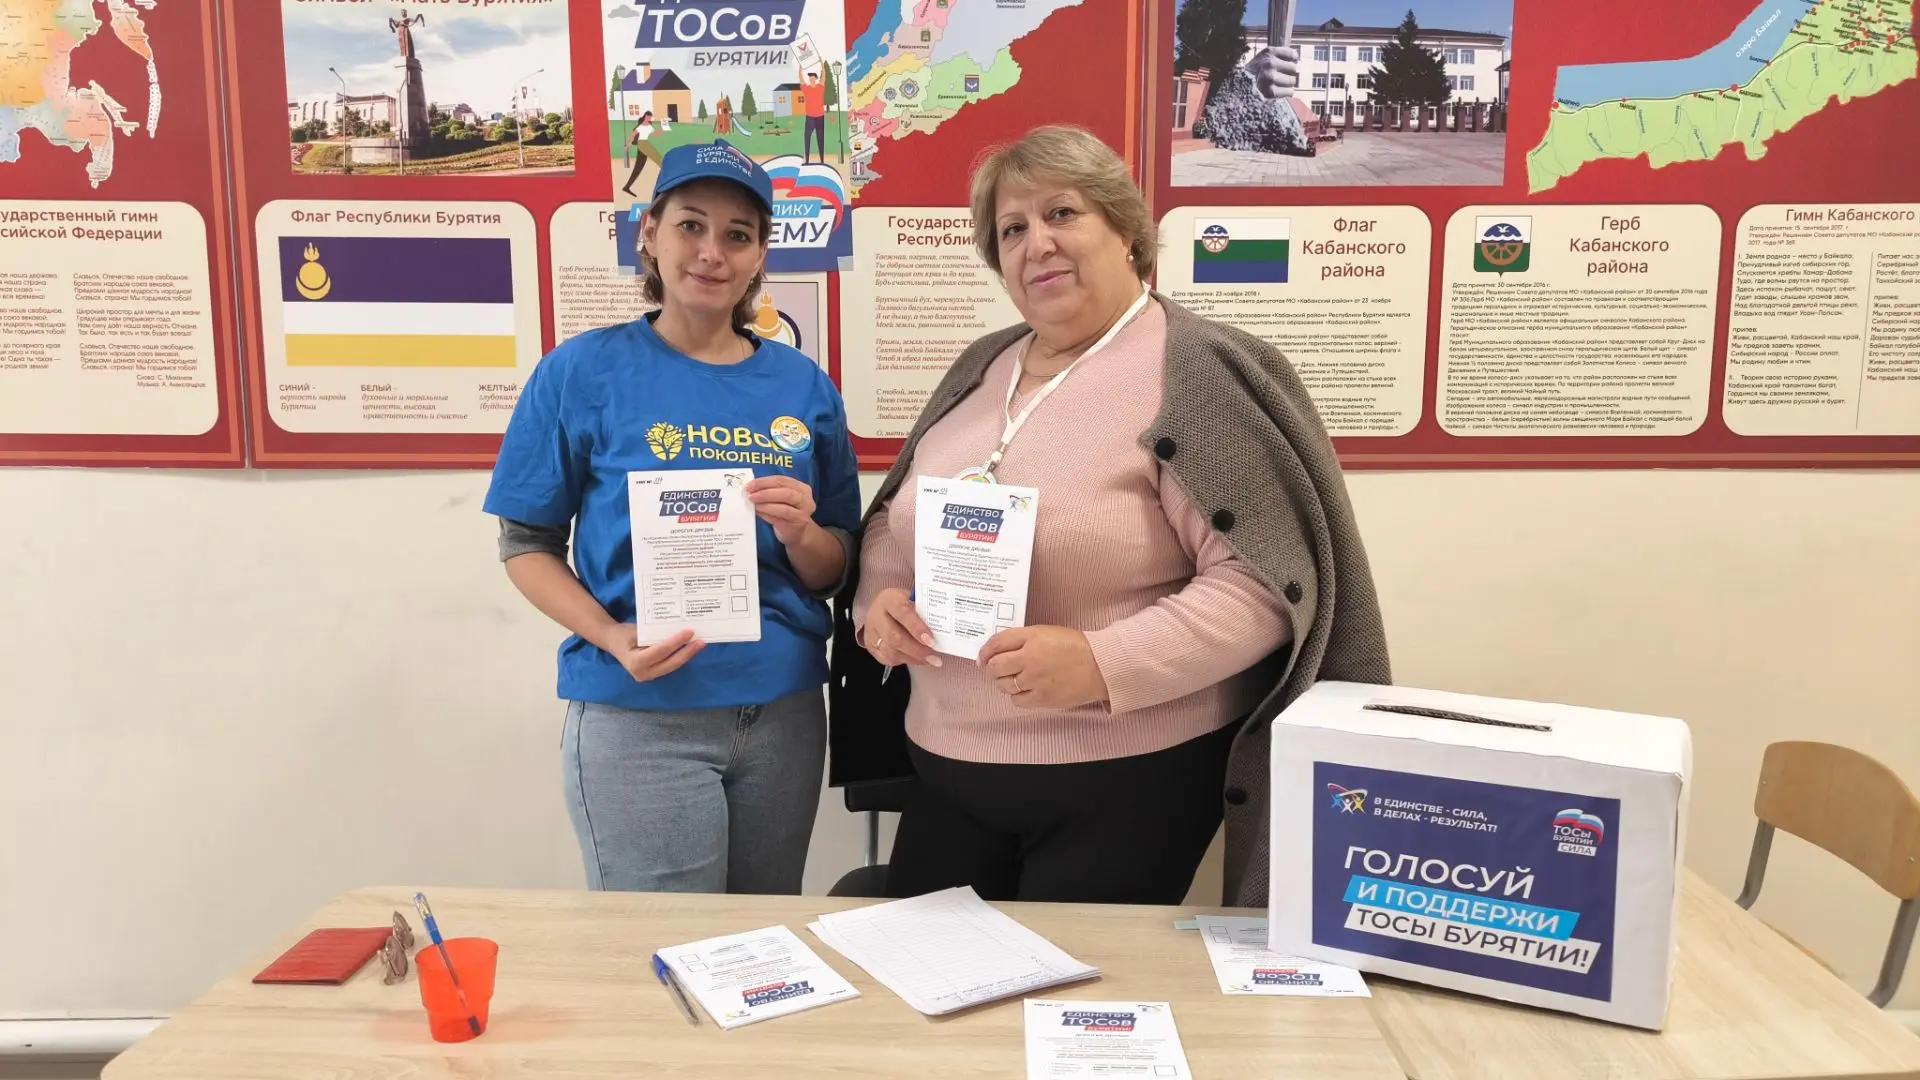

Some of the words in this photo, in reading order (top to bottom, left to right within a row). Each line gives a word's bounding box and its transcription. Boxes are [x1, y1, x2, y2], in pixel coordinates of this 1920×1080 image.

[648, 8, 792, 42] ТОСов
[1736, 36, 1756, 58] озеро
[1756, 8, 1782, 36] Байкал
[694, 51, 788, 66] БУРЯТИИ!
[697, 152, 740, 163] БУРЯТИИ
[1, 210, 115, 224] ударственный
[122, 212, 158, 222] гимн
[773, 204, 813, 216] ЛИКУ
[1786, 209, 1822, 222] Гимн
[1828, 208, 1914, 222] Кабанского
[291, 210, 330, 223] Флаг
[336, 211, 431, 226] Республики
[436, 211, 501, 226] Бурятия
[888, 216, 976, 230] Государств
[1334, 218, 1377, 232] Флаг
[1602, 216, 1640, 234] Герб
[1, 226, 66, 238] сийской
[72, 227, 162, 240] Федерации
[768, 222, 829, 244] ЕМУ
[897, 233, 974, 247] Республи
[1303, 240, 1406, 254] Кабанского
[1570, 238, 1669, 252] Кабанского
[1322, 262, 1384, 280] района
[1588, 260, 1648, 276] района
[280, 384, 310, 392] СИНИЙ
[361, 384, 392, 392] БЕЛЫЙ
[687, 424, 775, 449] НОВО
[690, 446, 792, 468] ПОКОЛЕНИЕ
[664, 490, 717, 500] ЕДИНСТВО
[664, 502, 717, 514] ТОСов
[947, 504, 1000, 518] ЕДИНСТВО
[947, 516, 998, 532] ТОСов
[1384, 799, 1443, 814] ЕДИНСТВЕ
[1452, 808, 1488, 821] СИЛА,
[1374, 808, 1381, 816] В
[1384, 809, 1421, 822] ДЕЛАХ
[1430, 816, 1498, 832] РЕЗУЛЬТАТ!
[1553, 826, 1591, 838] ТОСы
[1553, 835, 1593, 845] БУРЯТИИ
[1560, 845, 1592, 856] СИЛА
[1344, 846, 1534, 898] ГОЛОСУЙ
[1358, 882, 1378, 900] И
[1386, 888, 1559, 934] ПОДДЕРЖИ
[1358, 909, 1437, 938] ТОСЫ
[1444, 926, 1589, 966] БУРЯТИИ!
[746, 982, 807, 999] ТОСов
[1068, 1018, 1132, 1026] ТОСов
